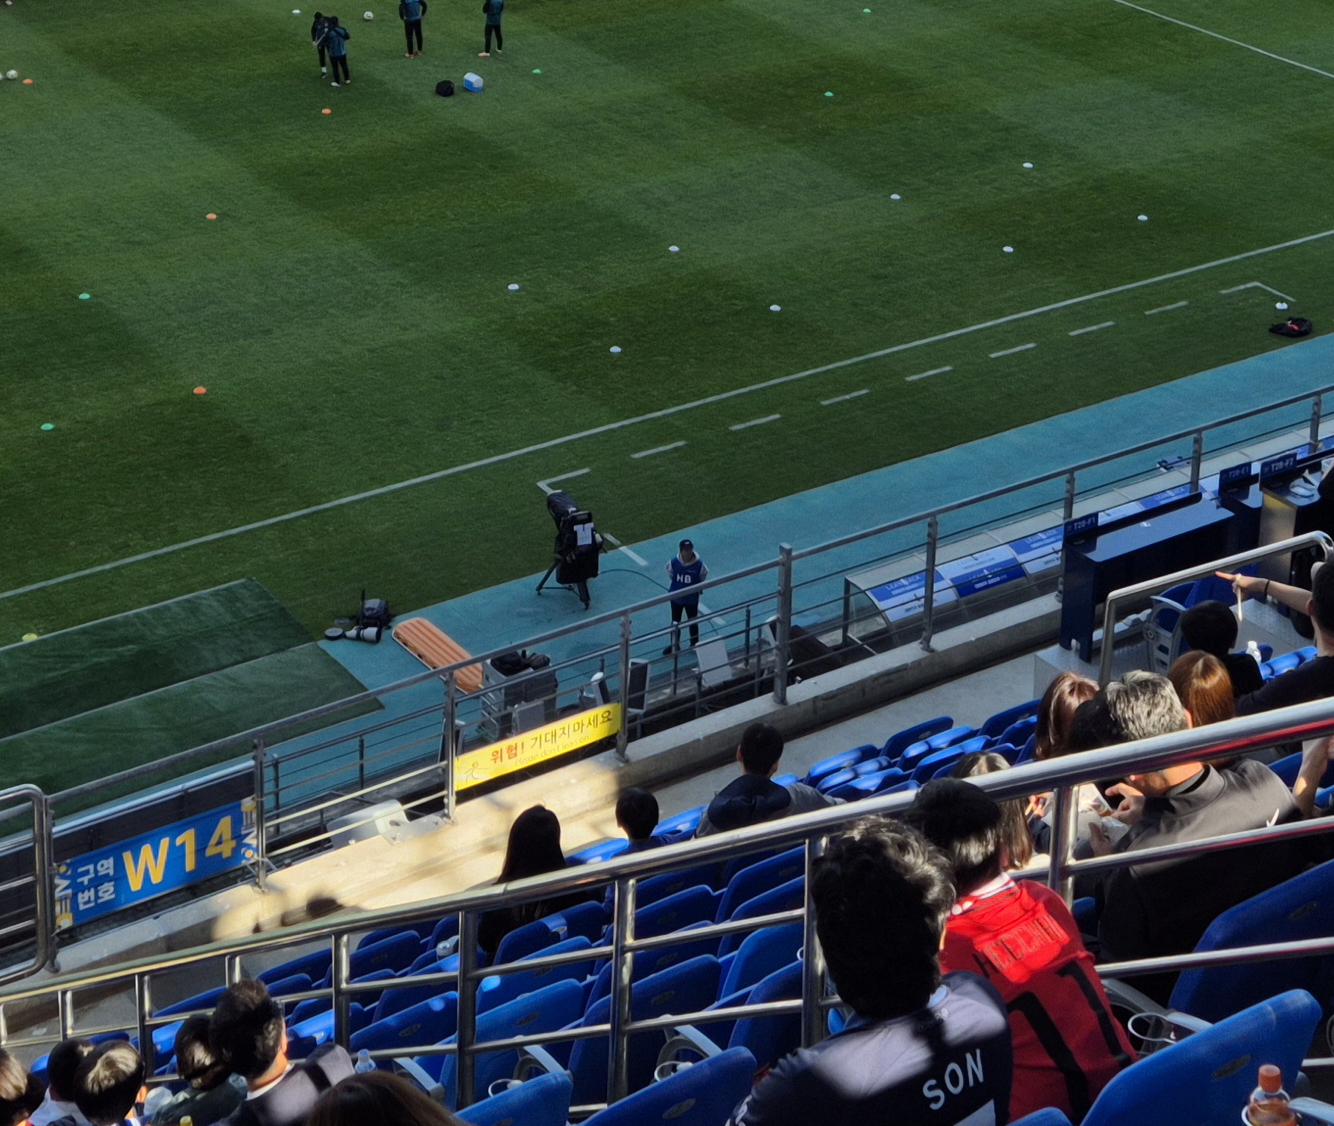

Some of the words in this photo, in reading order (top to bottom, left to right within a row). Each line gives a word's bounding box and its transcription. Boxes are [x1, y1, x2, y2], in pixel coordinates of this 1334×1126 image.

[490, 740, 525, 765] 위험!
[529, 709, 613, 751] 기대지마세요
[77, 856, 115, 886] 구역
[122, 815, 238, 892] W14
[77, 879, 116, 911] 번호
[922, 1046, 985, 1112] SON
